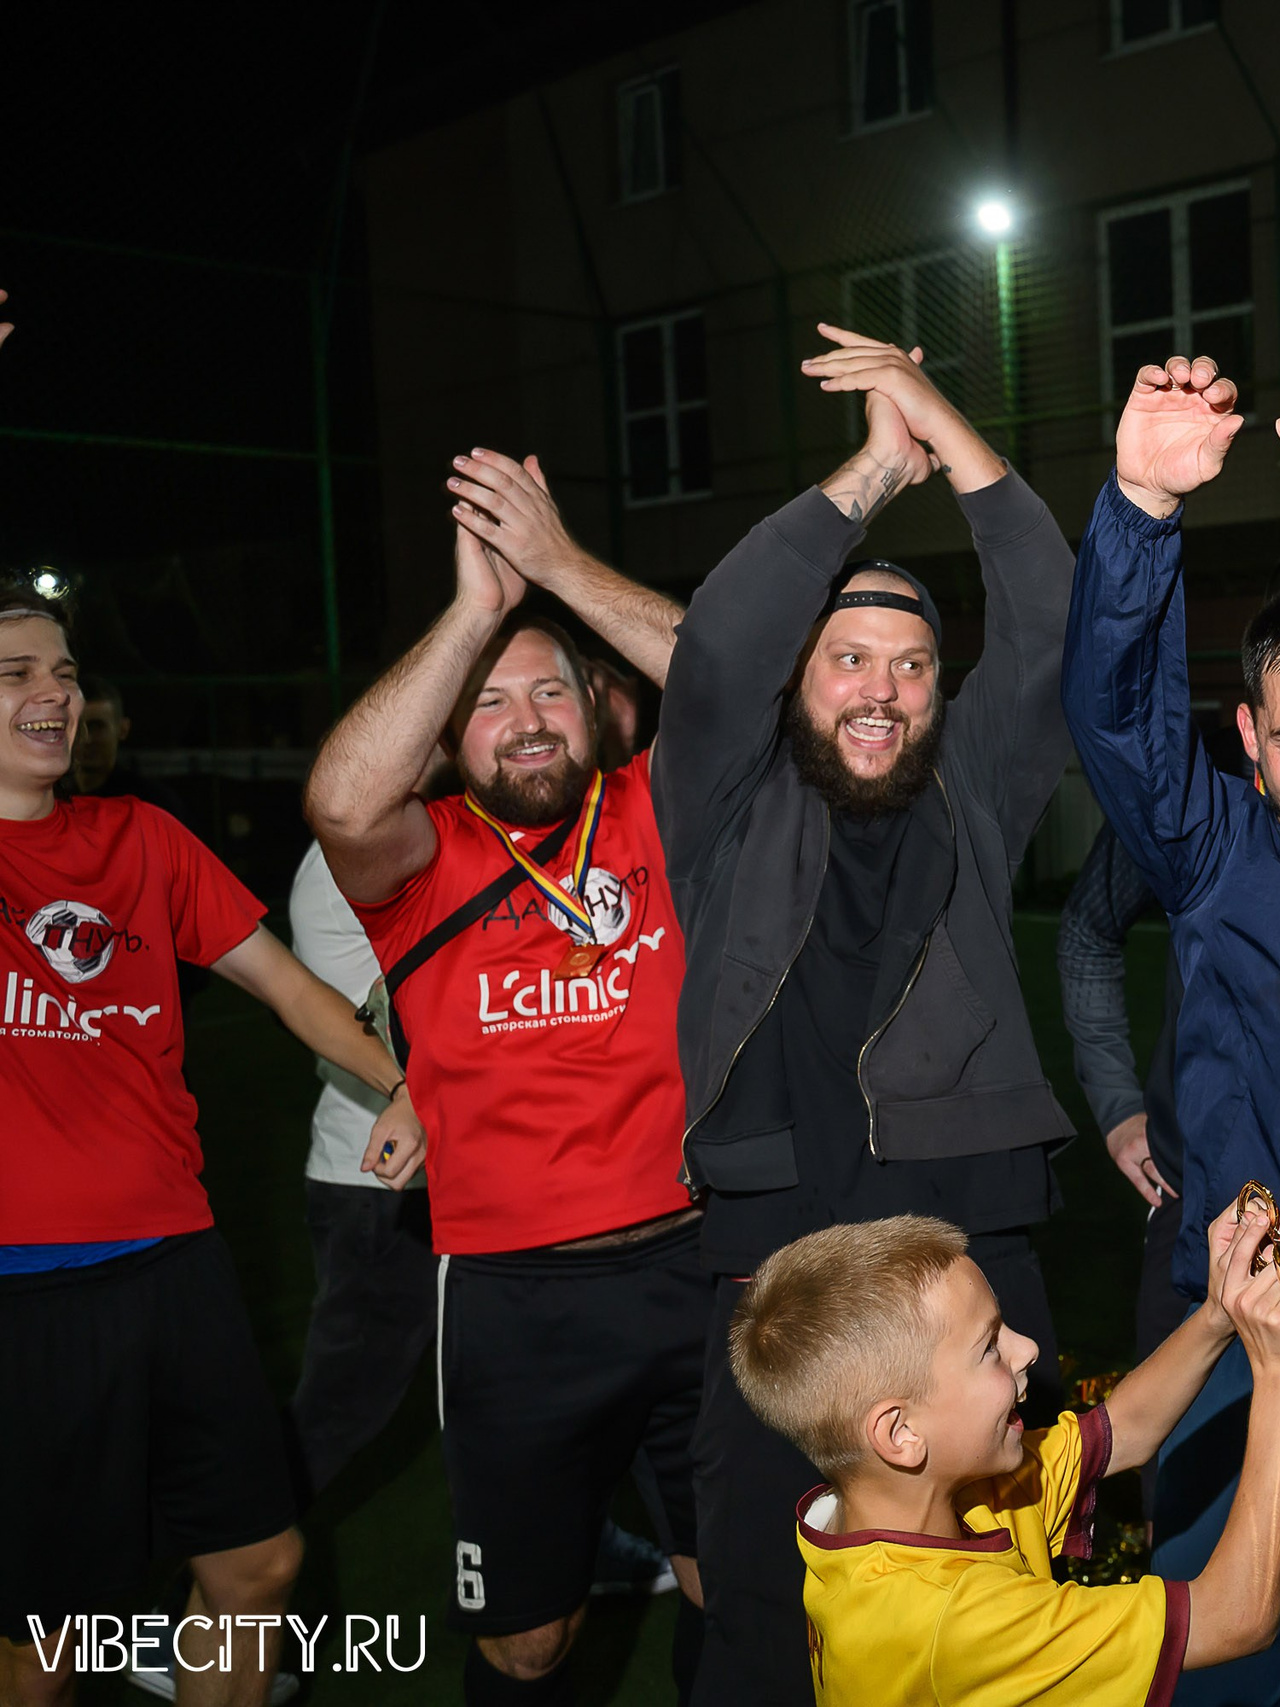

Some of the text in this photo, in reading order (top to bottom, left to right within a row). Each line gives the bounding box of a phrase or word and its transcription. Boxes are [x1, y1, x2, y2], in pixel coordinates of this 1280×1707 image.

[482, 866, 648, 931] ДА НУТЬ
[4, 971, 102, 1038] linic
[482, 1019, 546, 1035] авторская
[456, 1540, 486, 1612] 6
